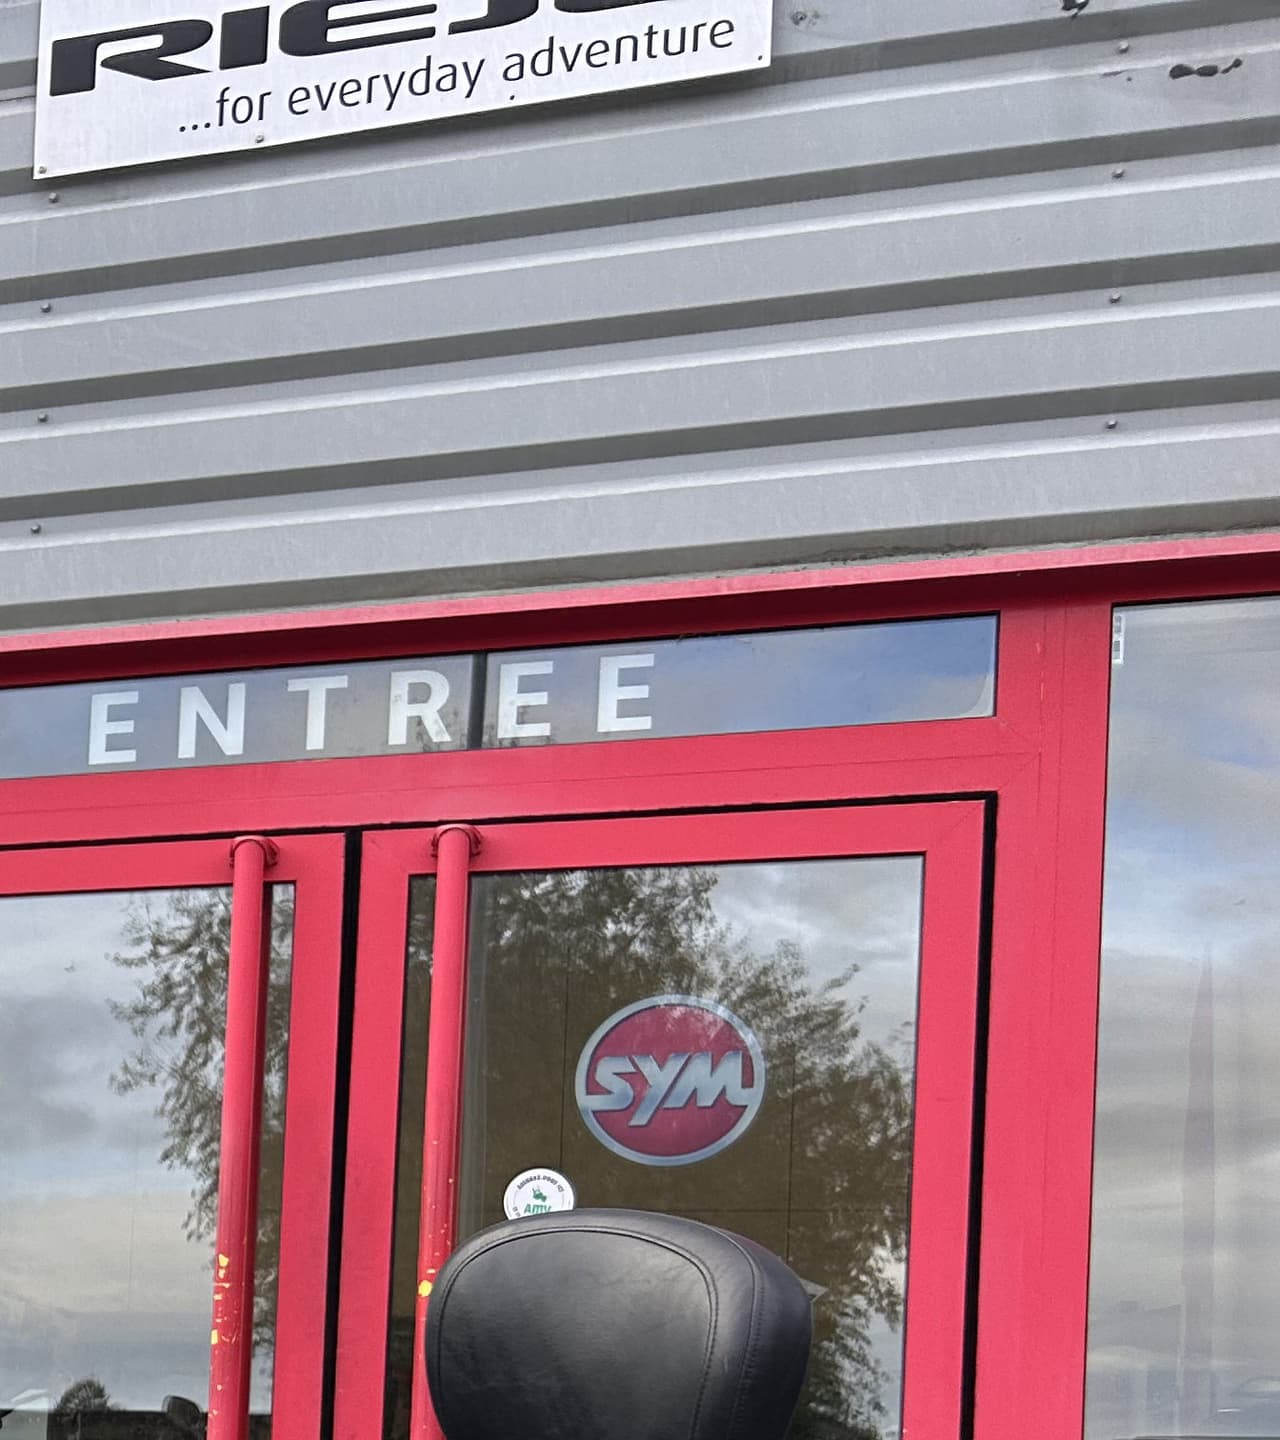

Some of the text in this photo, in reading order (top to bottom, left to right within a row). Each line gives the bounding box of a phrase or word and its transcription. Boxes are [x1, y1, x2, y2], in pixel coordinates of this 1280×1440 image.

[48, 0, 662, 97] RIEJ
[287, 54, 486, 115] everyday
[501, 19, 736, 83] adventure
[87, 653, 655, 766] ENTREE
[585, 1050, 752, 1127] SYM
